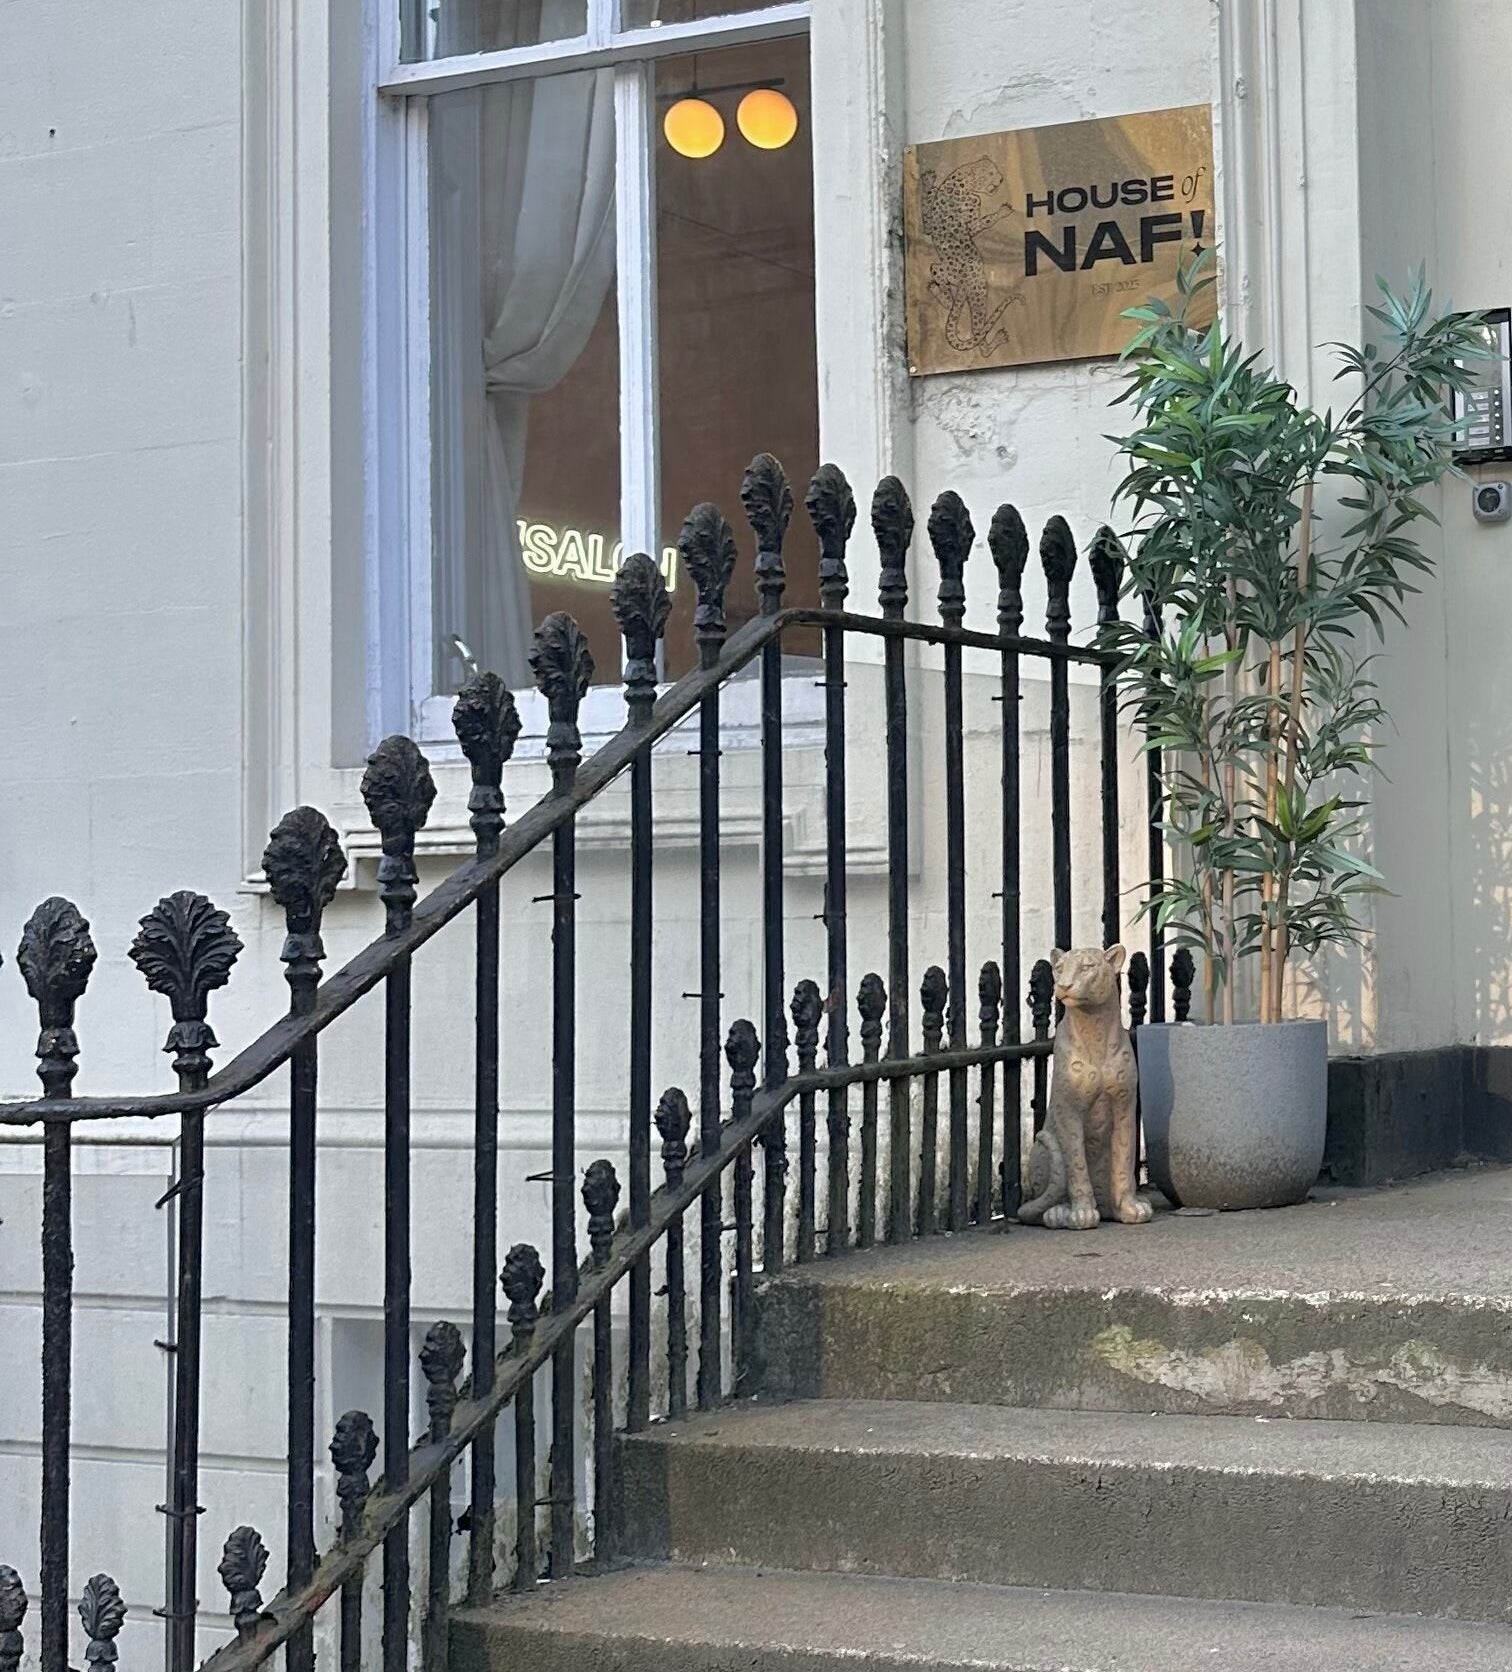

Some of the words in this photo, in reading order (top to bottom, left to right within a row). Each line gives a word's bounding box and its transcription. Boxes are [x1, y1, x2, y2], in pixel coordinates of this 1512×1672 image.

[1026, 175, 1175, 217] HOUSE
[1182, 166, 1206, 203] of
[1024, 210, 1205, 276] NAF!
